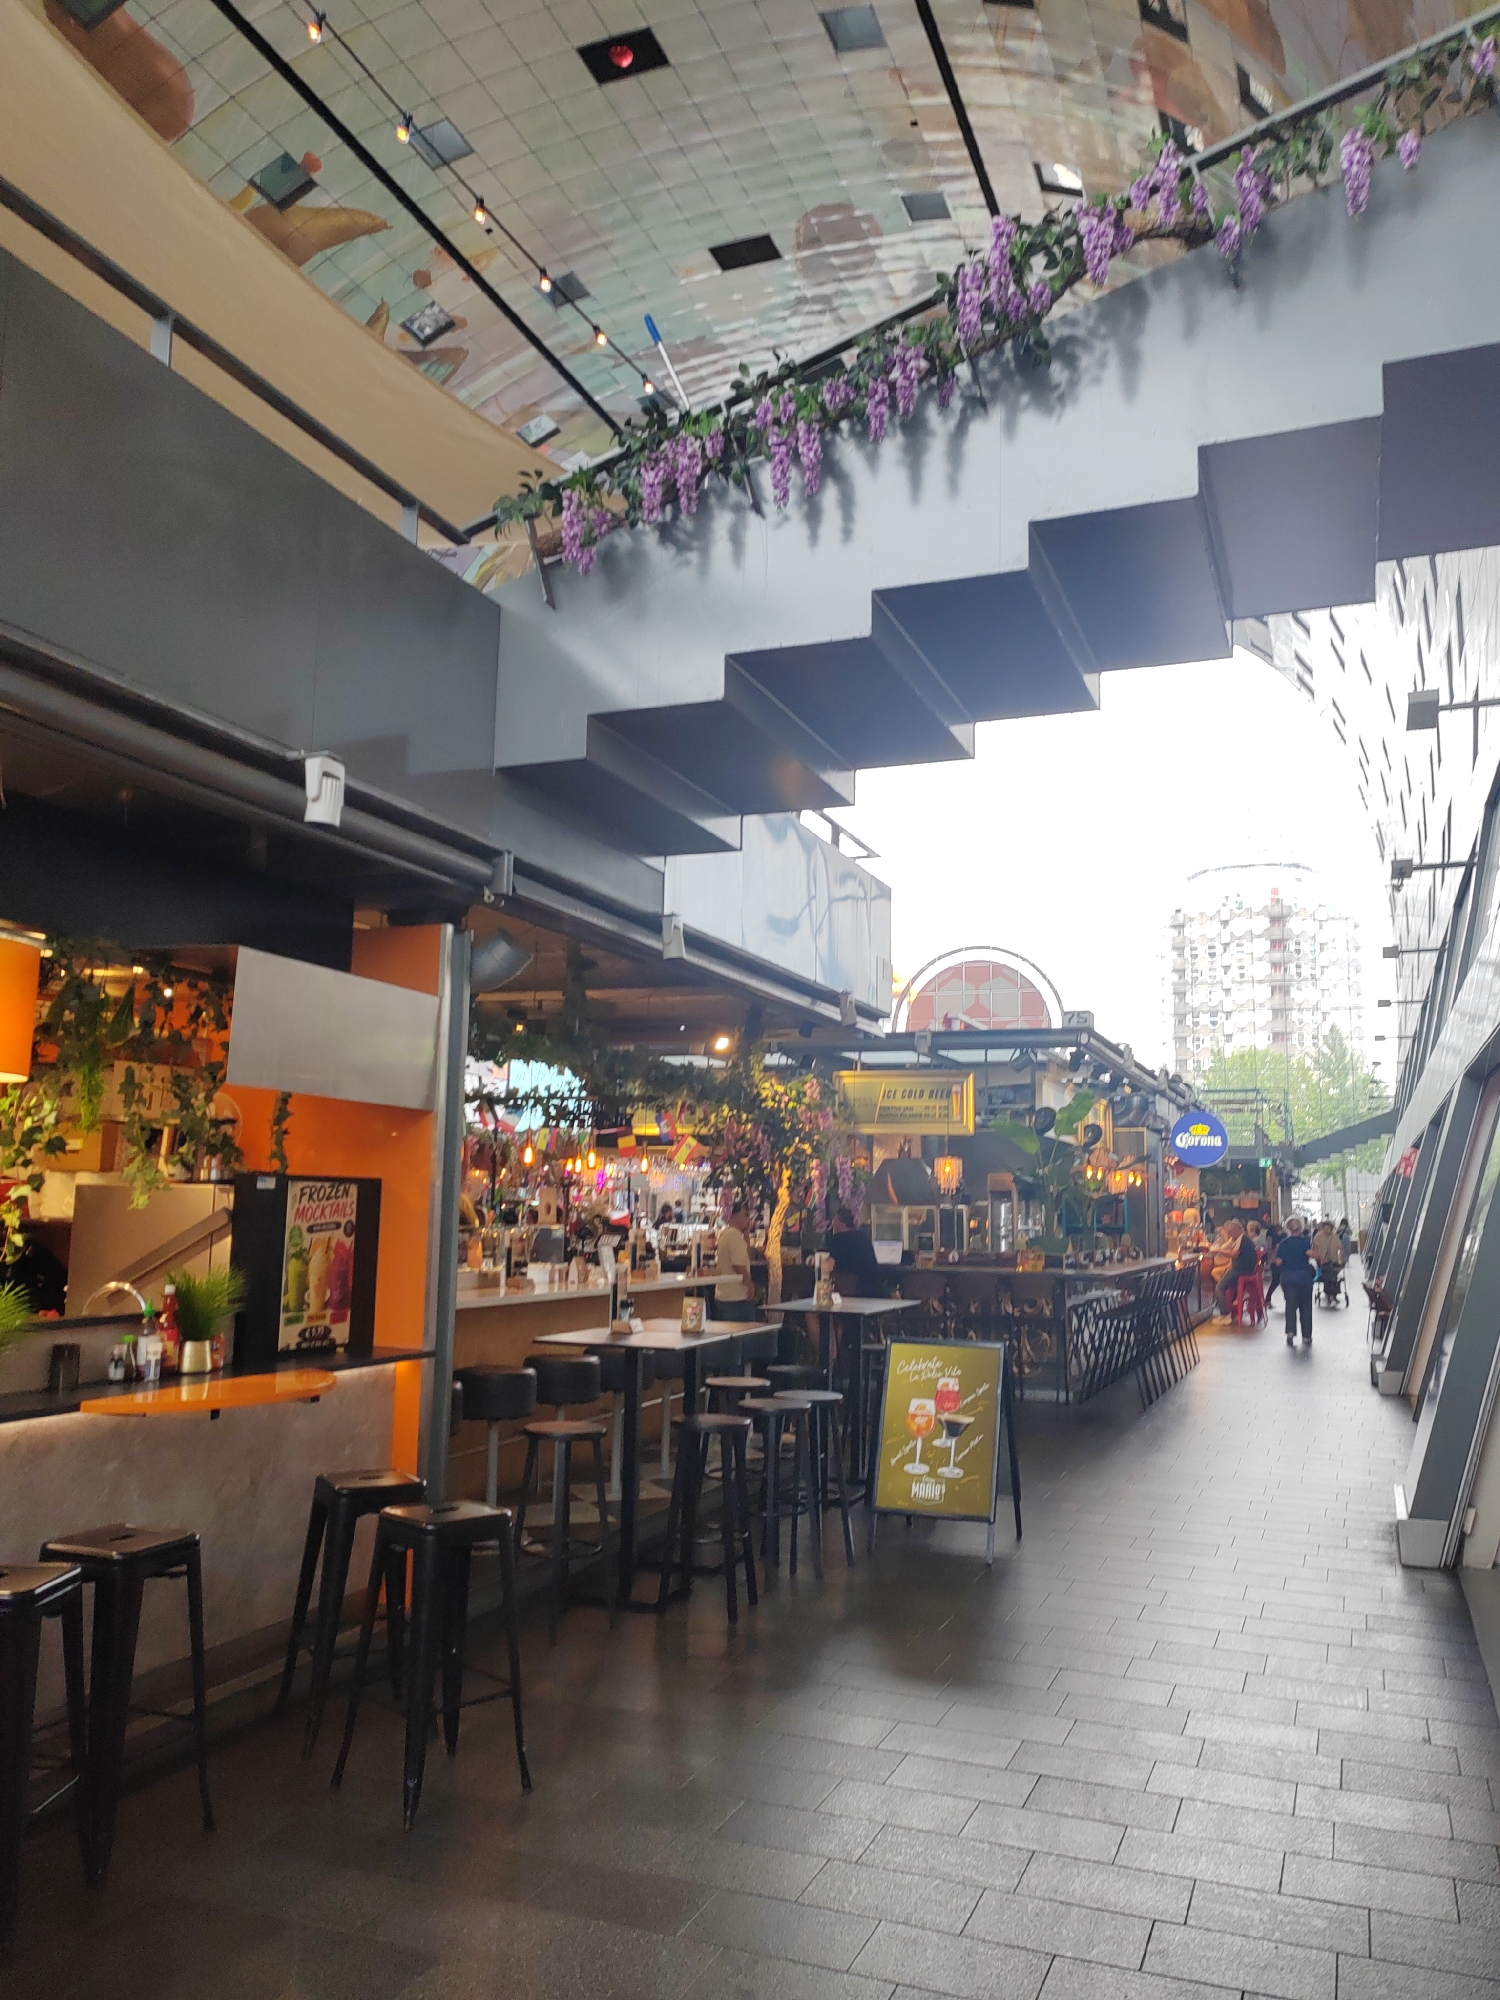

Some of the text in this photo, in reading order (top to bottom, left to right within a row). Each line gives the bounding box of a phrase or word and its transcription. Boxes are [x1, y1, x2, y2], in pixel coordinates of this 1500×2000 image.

[883, 1088, 952, 1100] ICE COLD BEER
[1175, 1131, 1223, 1150] Corona
[299, 1182, 352, 1205] FROZEN
[293, 1201, 355, 1223] MOCKTAILS
[896, 1355, 944, 1375] Celebrate
[921, 1367, 943, 1381] Dolce
[944, 1365, 963, 1377] Vita
